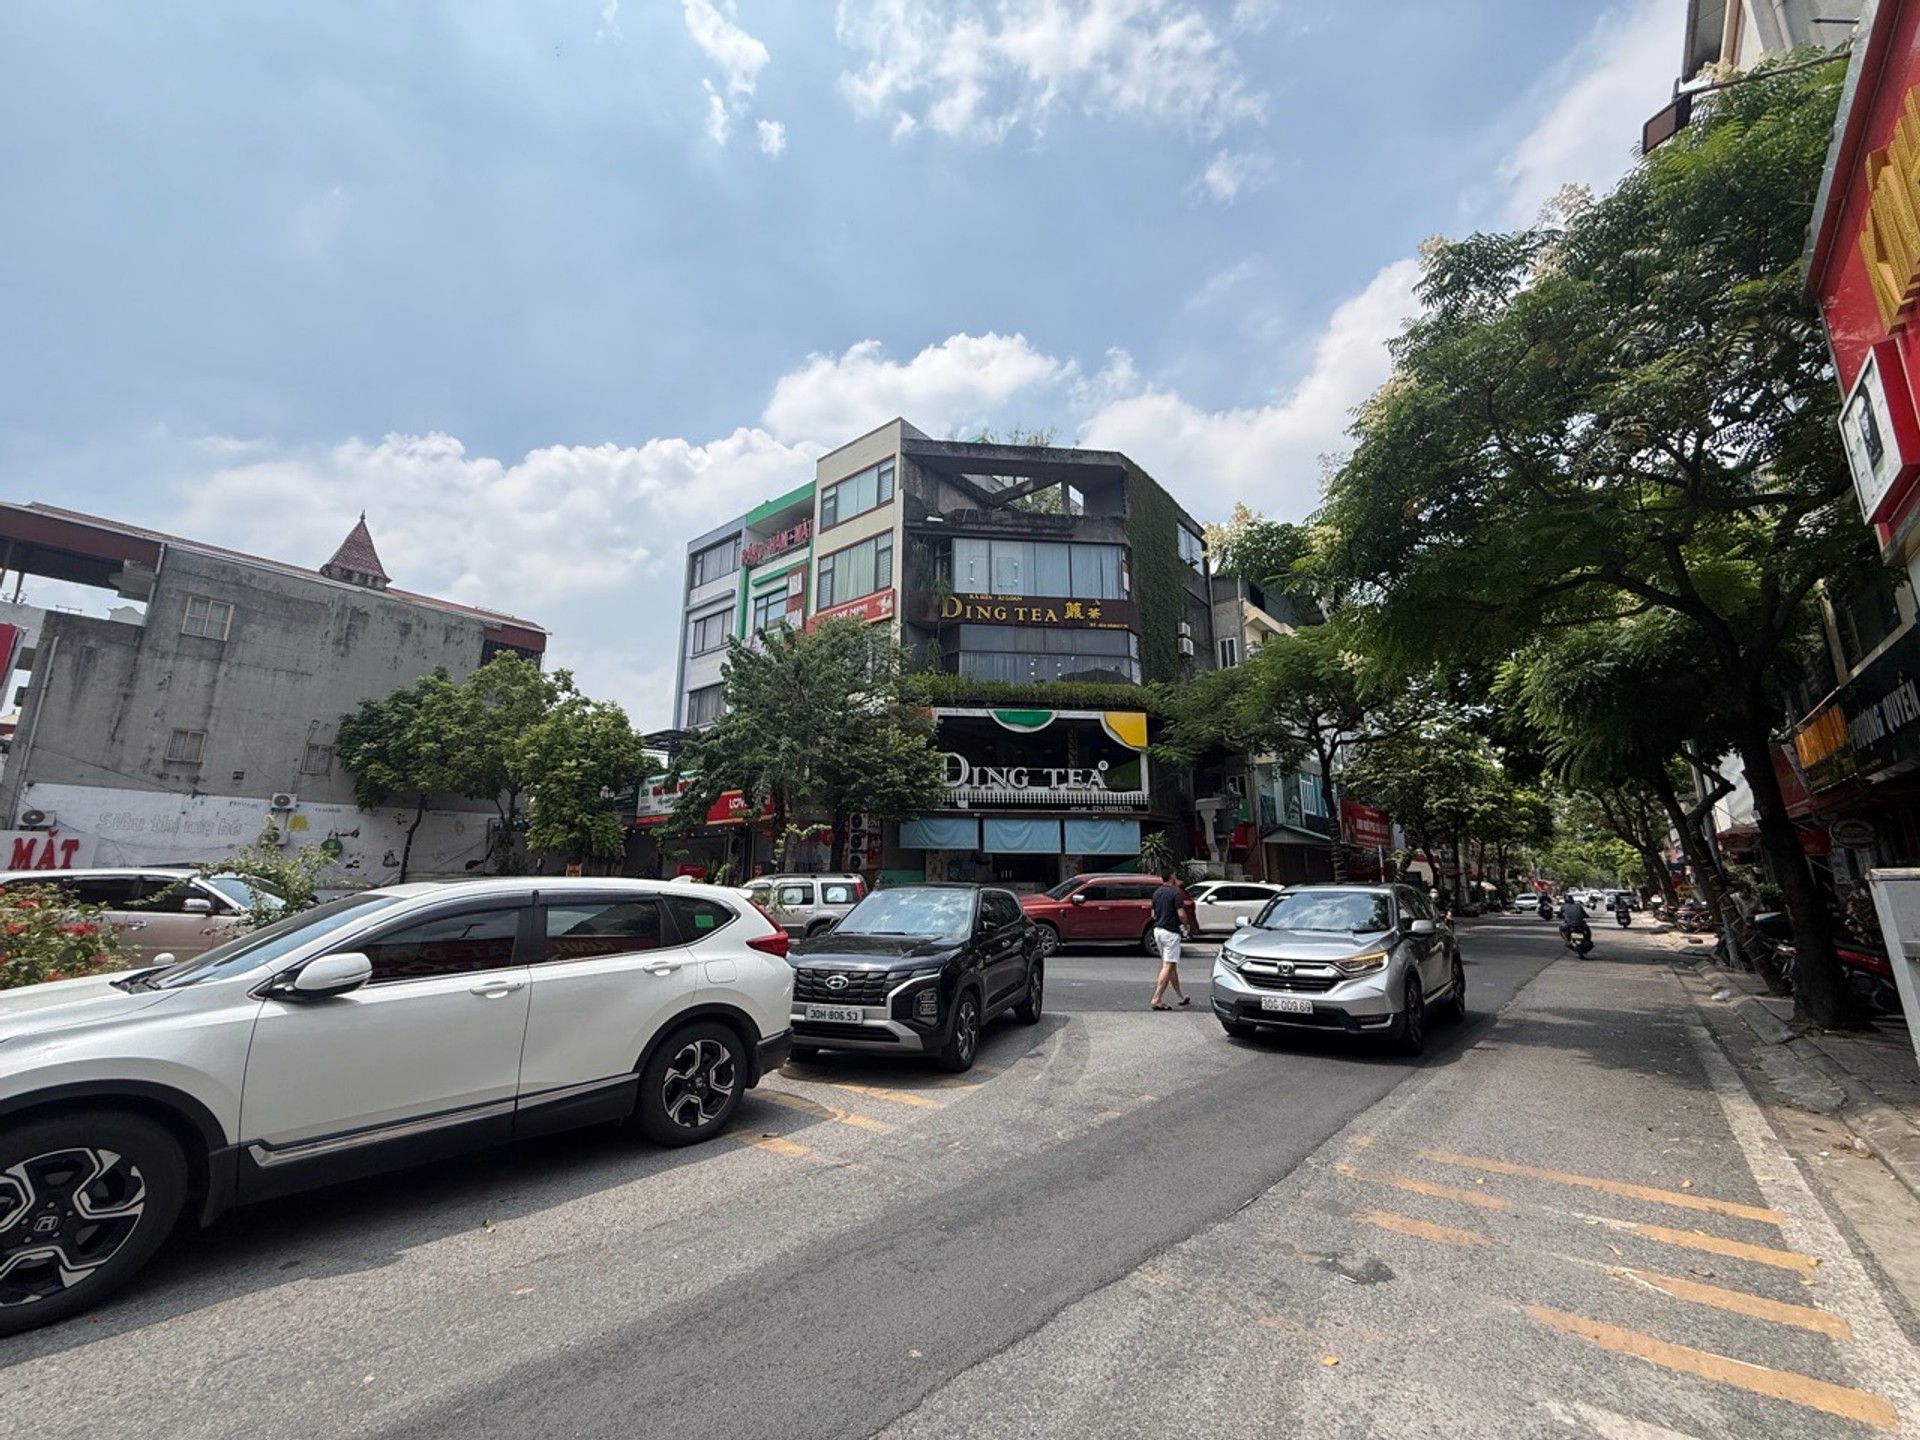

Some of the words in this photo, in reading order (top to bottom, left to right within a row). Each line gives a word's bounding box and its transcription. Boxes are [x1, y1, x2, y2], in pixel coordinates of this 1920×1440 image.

[941, 597, 1008, 620] DING
[1014, 608, 1058, 623] TEA
[940, 752, 1030, 789] DING
